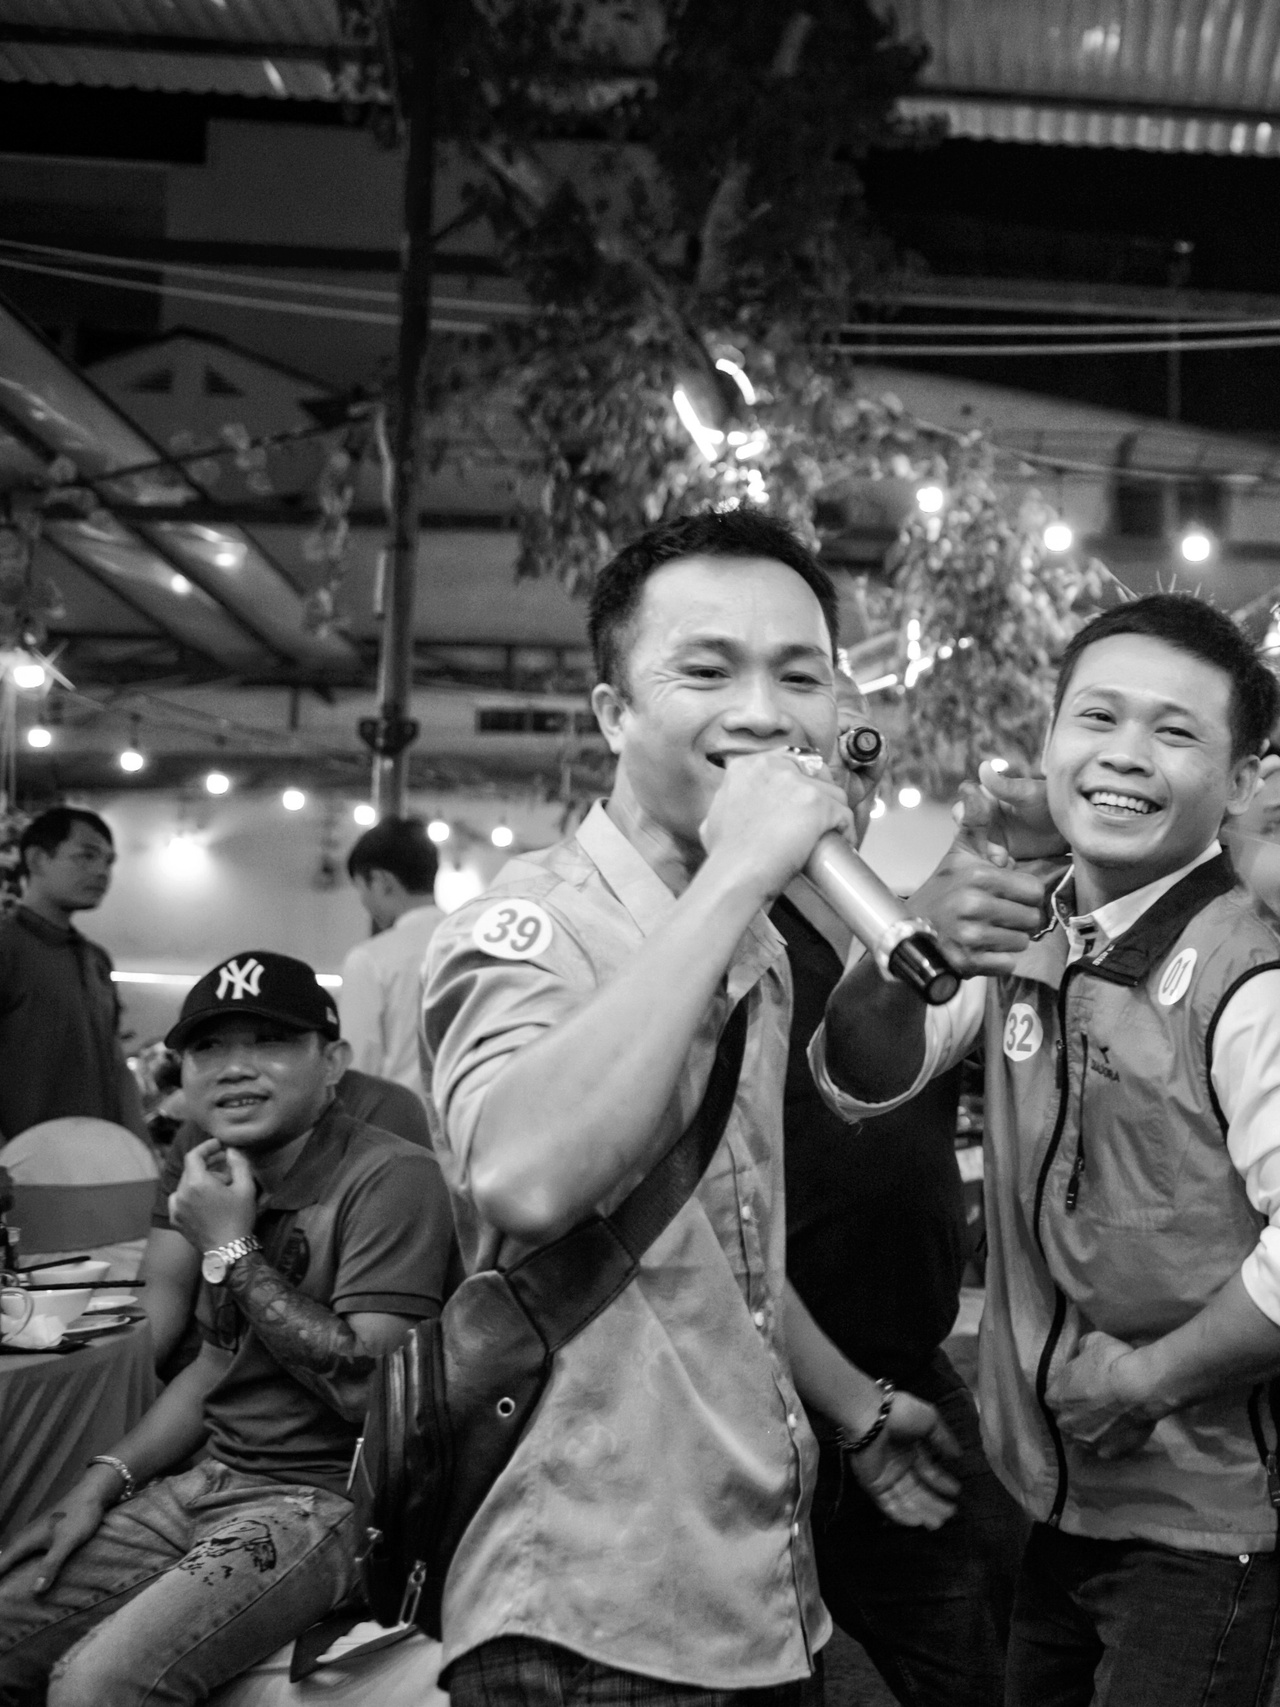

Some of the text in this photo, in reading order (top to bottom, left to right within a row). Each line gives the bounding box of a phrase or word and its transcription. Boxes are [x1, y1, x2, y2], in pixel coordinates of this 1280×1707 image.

[483, 908, 542, 952] 39
[215, 958, 265, 1000] NY
[1162, 957, 1192, 996] 01
[1006, 1012, 1034, 1053] 32
